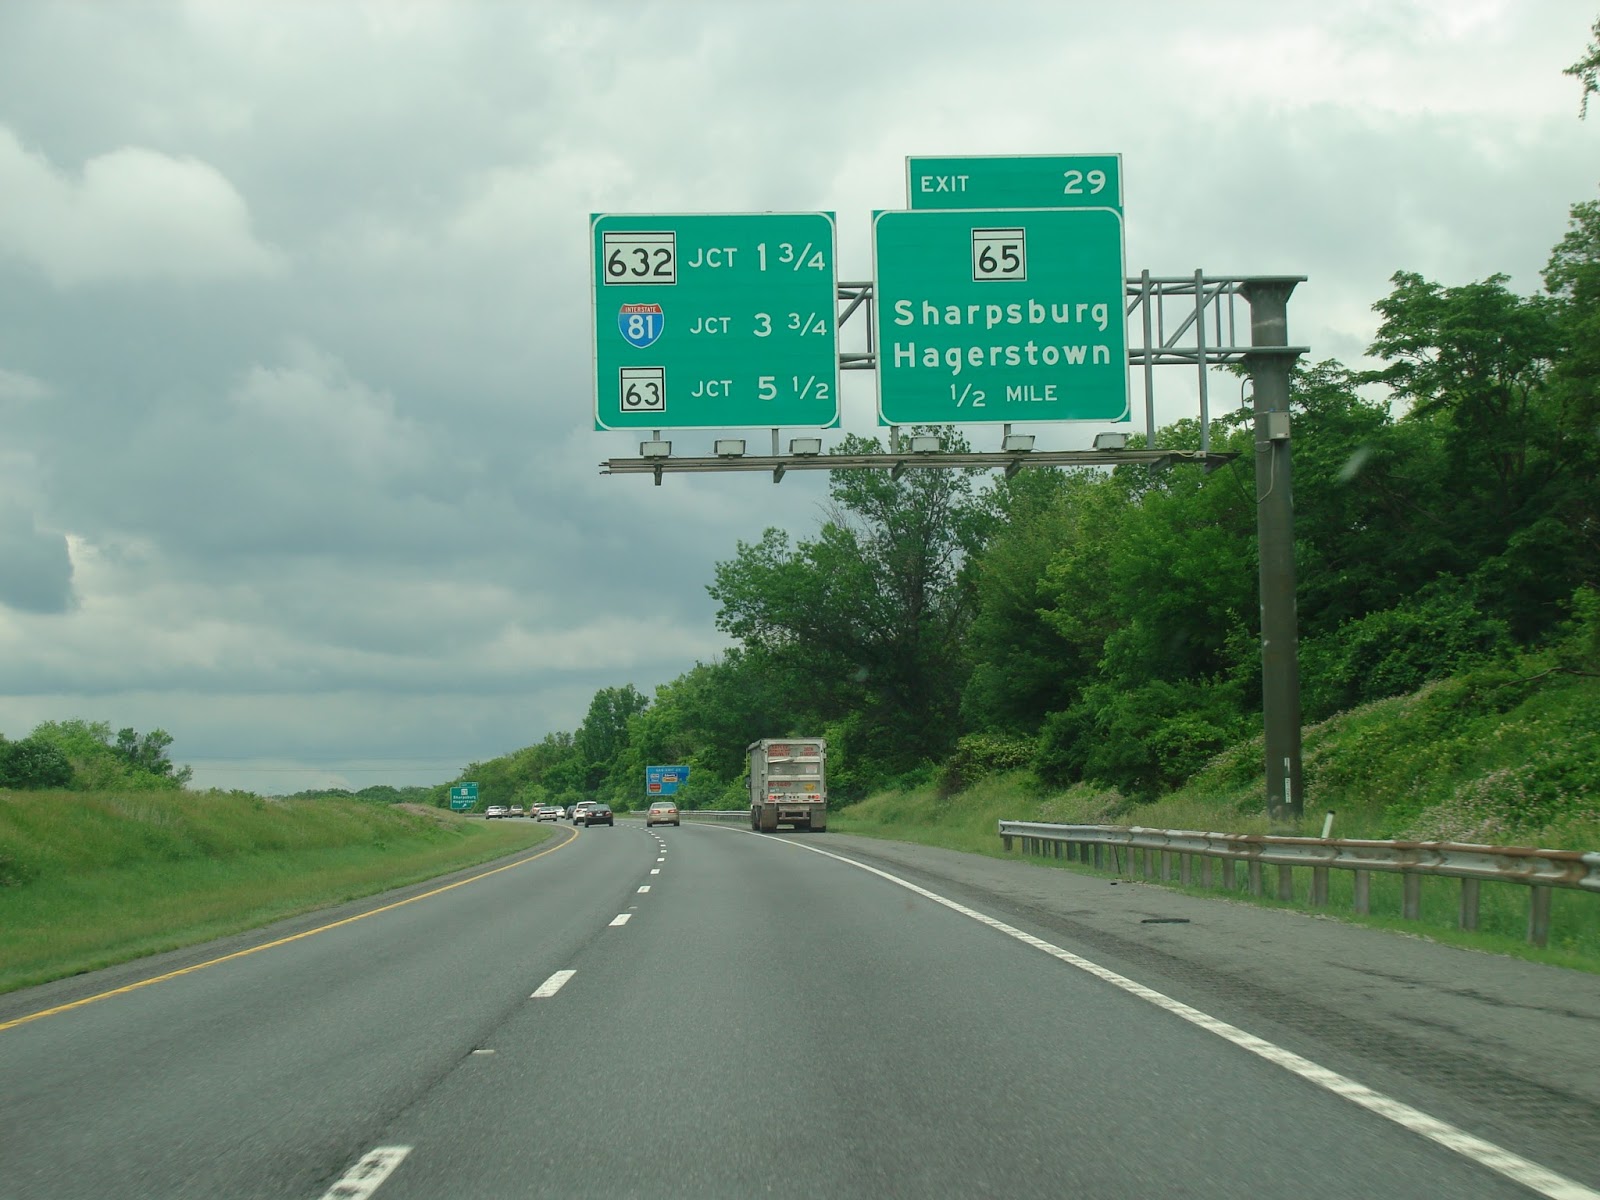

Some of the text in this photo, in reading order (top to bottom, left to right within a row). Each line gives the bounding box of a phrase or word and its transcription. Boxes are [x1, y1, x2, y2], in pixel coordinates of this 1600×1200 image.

[921, 170, 1106, 194] EXIT 29
[608, 248, 673, 277] 632
[688, 242, 826, 271] JCT 1 3/4
[978, 245, 1020, 273] 65
[628, 314, 653, 339] 81
[690, 312, 827, 337] JCT 3 3/4
[894, 298, 1109, 332] Sharpsburg
[894, 340, 1110, 376] Hagerstown
[626, 382, 660, 407] 63
[691, 375, 829, 400] JCT 5 1/2
[950, 383, 1057, 407] 1/2 MILE
